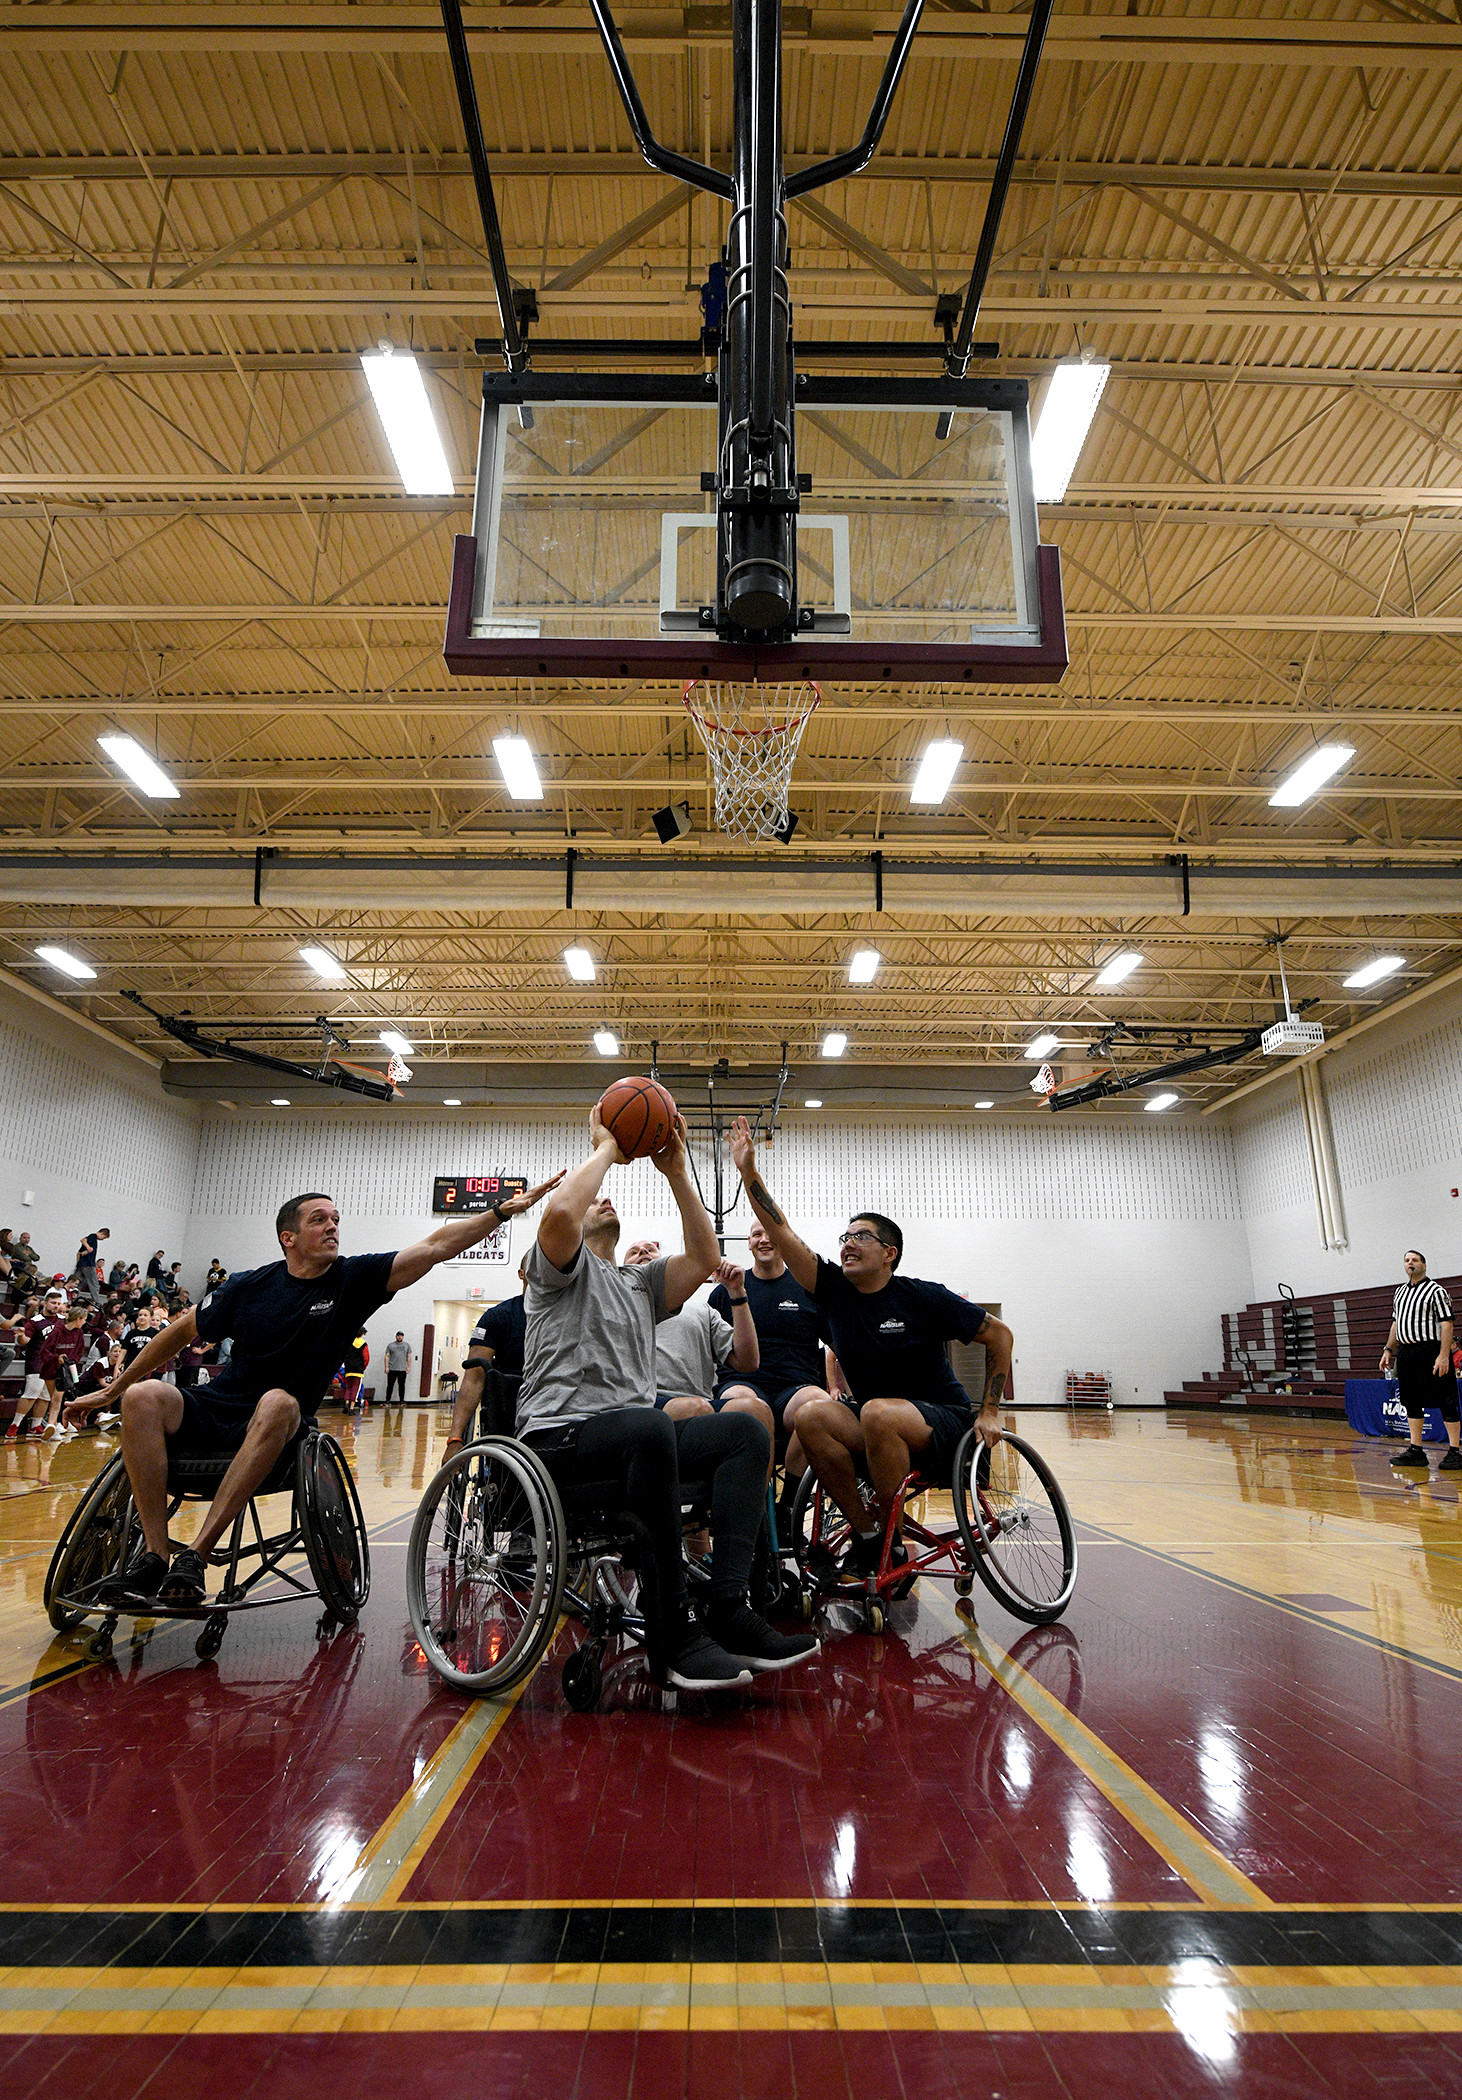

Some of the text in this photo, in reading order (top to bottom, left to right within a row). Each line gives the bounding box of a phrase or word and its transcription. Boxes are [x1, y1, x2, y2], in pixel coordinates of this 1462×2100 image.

[466, 1178, 499, 1192] 10:09
[445, 1188, 456, 1203] 2
[457, 1251, 504, 1260] ILDCATS
